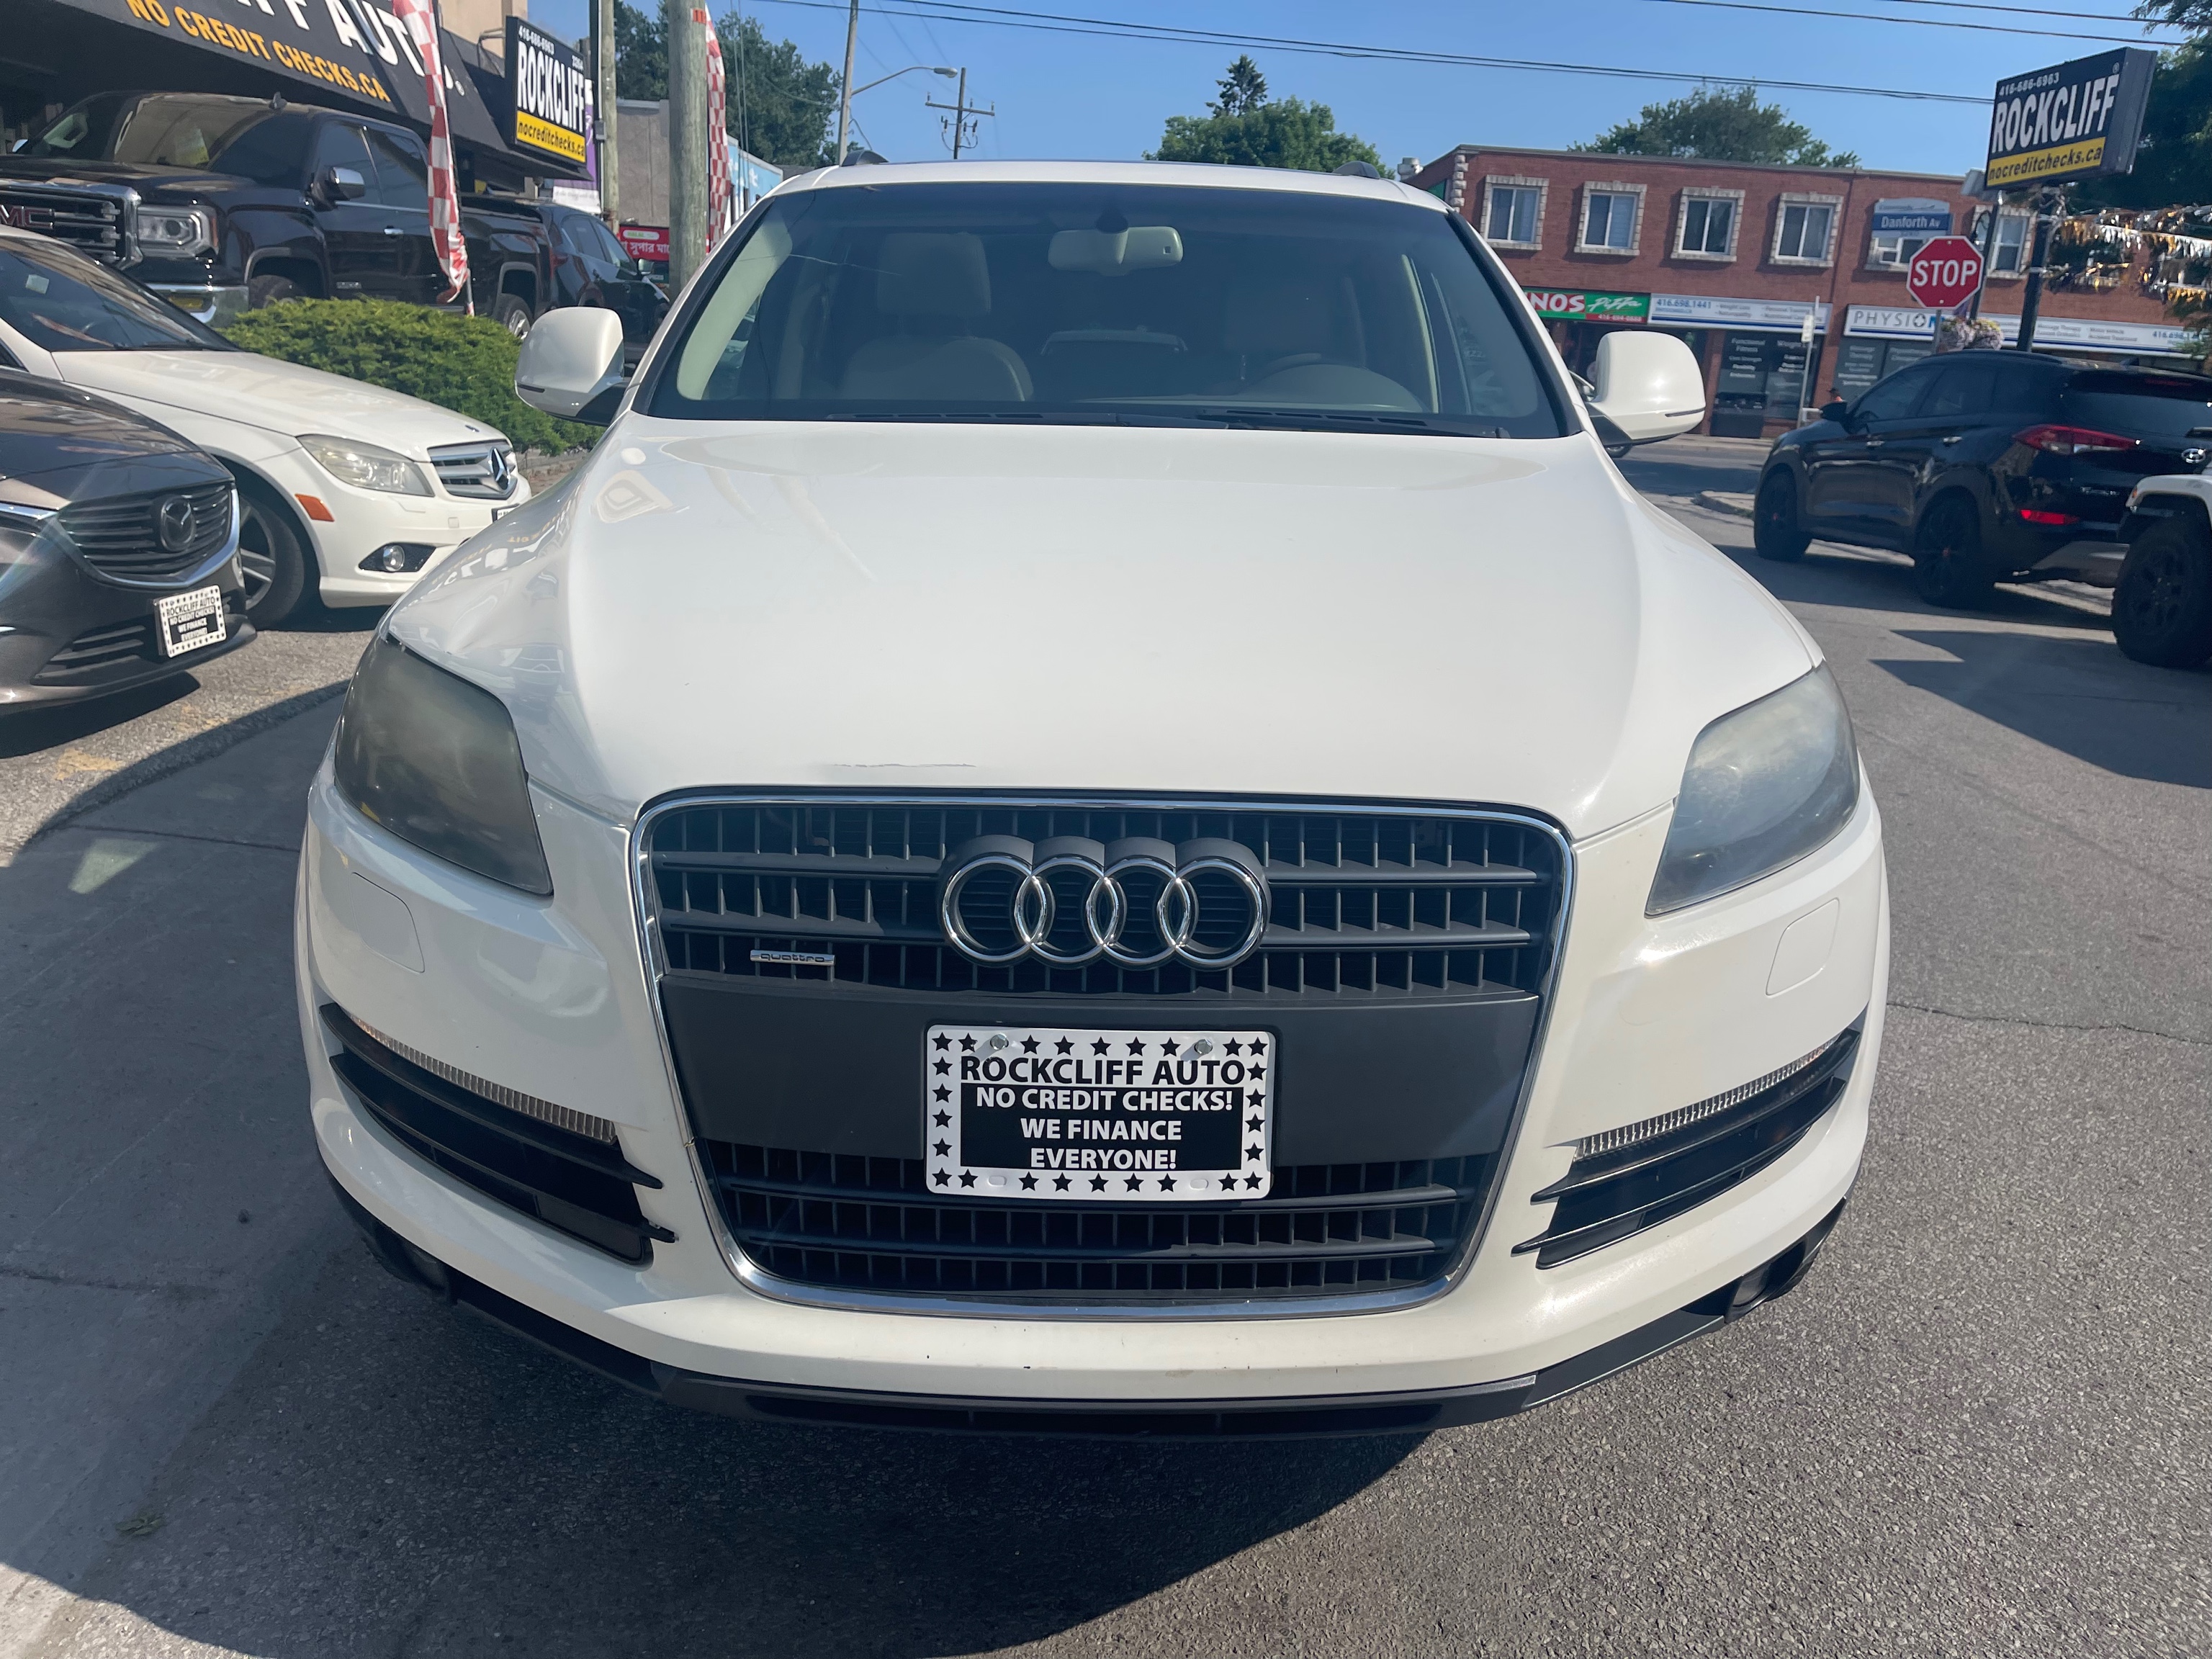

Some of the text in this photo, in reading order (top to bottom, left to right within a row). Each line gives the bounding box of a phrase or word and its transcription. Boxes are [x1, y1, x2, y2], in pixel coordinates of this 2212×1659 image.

[125, 0, 171, 27] NO
[174, 6, 271, 61] CREDIT
[271, 40, 391, 102] CHECKS.CA
[325, 0, 454, 90] AUT
[518, 40, 584, 133] ROCKCLIFF
[1999, 72, 2059, 96] 416-686-6963
[1992, 73, 2120, 153] ROCKCLIFF
[518, 122, 585, 156] nocreditchecks.ca
[1989, 146, 2102, 180] nocreditchecks.ca
[1881, 216, 1941, 228] Danforth Av
[1912, 259, 1977, 287] STOP
[1526, 292, 1585, 313] NOS
[166, 596, 215, 616] ROCKCLIFF AUTO
[760, 953, 825, 963] quattro
[961, 1056, 1245, 1086] ROCKCLIFF AUTO
[976, 1087, 1233, 1111] NO CREDIT CHECKS!
[1020, 1118, 1182, 1141] WE FINANCE
[1030, 1148, 1176, 1170] EVERYONE!
